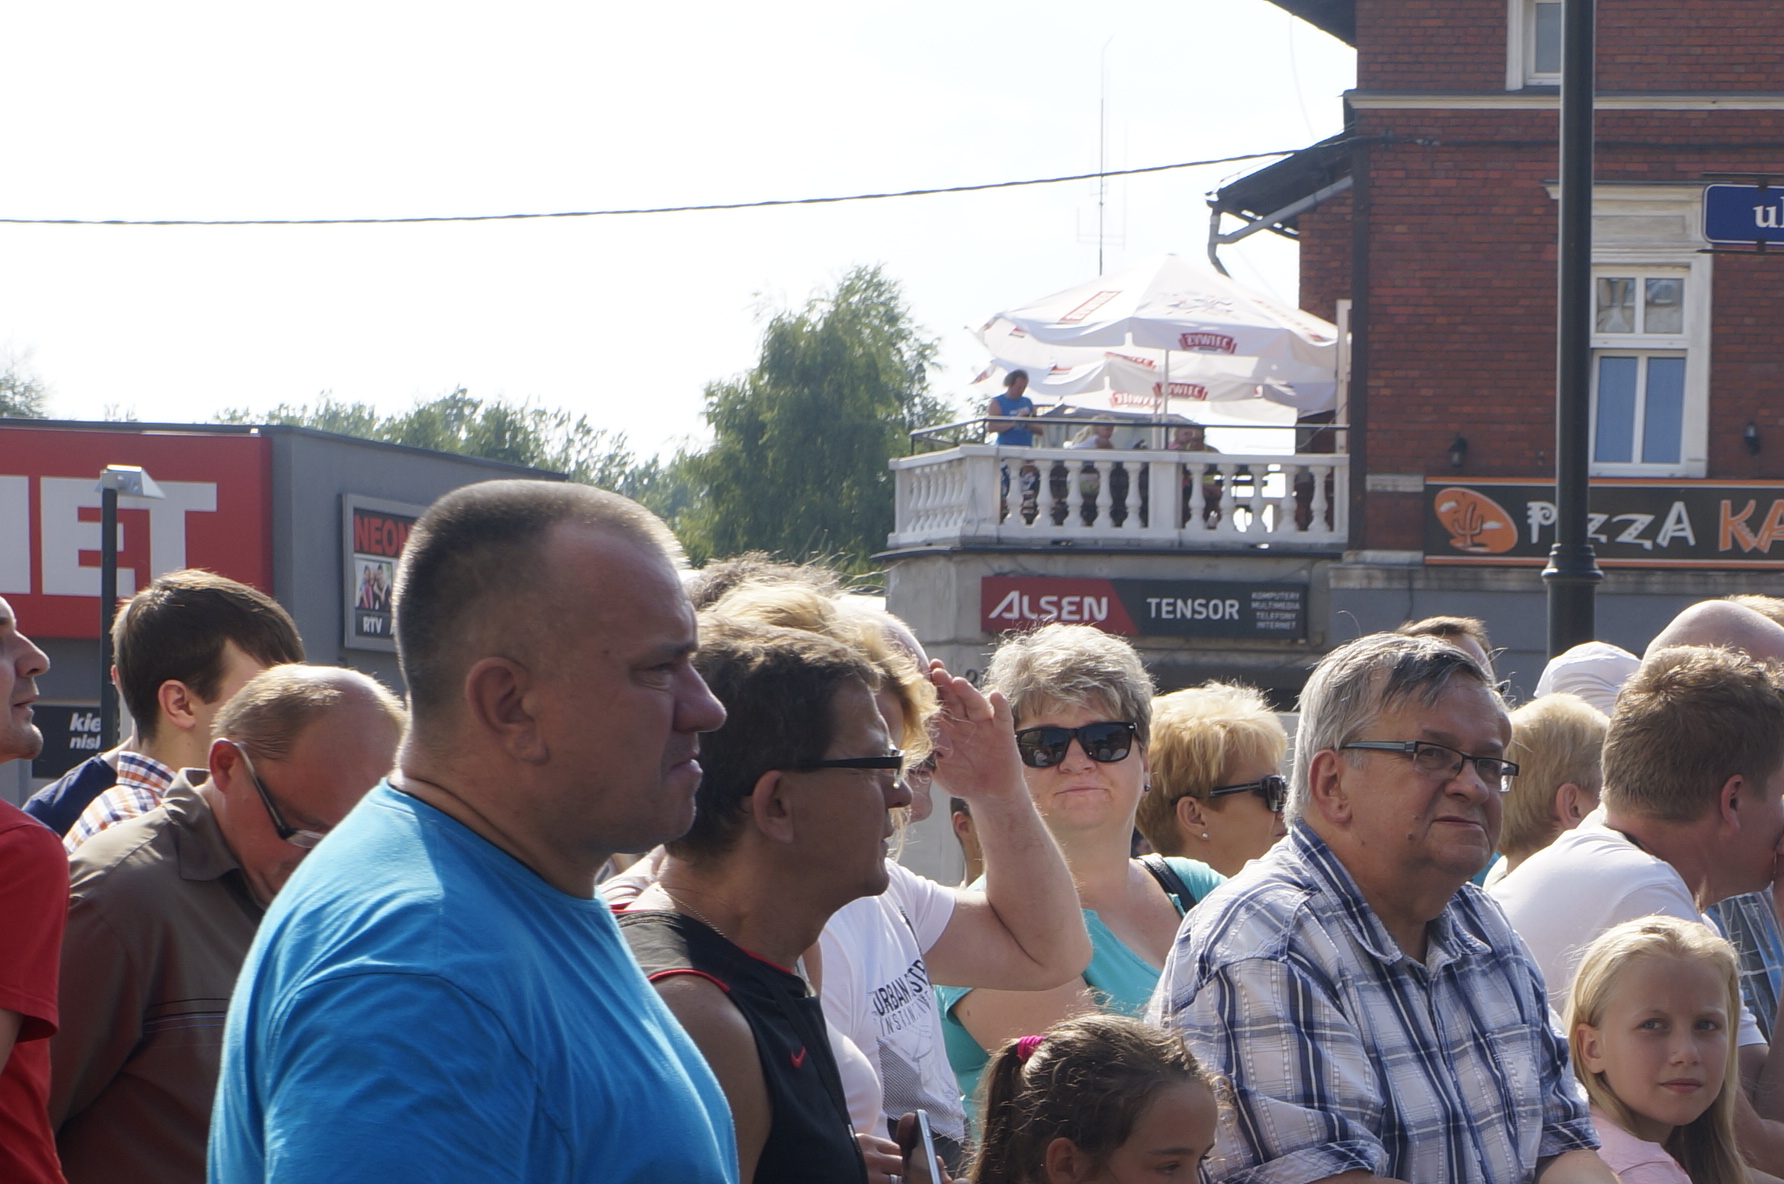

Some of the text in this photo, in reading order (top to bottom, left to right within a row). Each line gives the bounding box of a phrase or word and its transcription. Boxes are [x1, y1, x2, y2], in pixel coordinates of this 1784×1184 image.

[1526, 500, 1696, 551] PZZA
[1251, 591, 1300, 600] KOMPUTERY
[988, 590, 1240, 622] ALSEN TENSOR
[1250, 600, 1300, 610] MULTIMEDIA
[1255, 611, 1297, 620] TELEFONY
[362, 615, 383, 634] RTV
[1255, 621, 1297, 630] INTERNET
[872, 977, 913, 1017] URBAN
